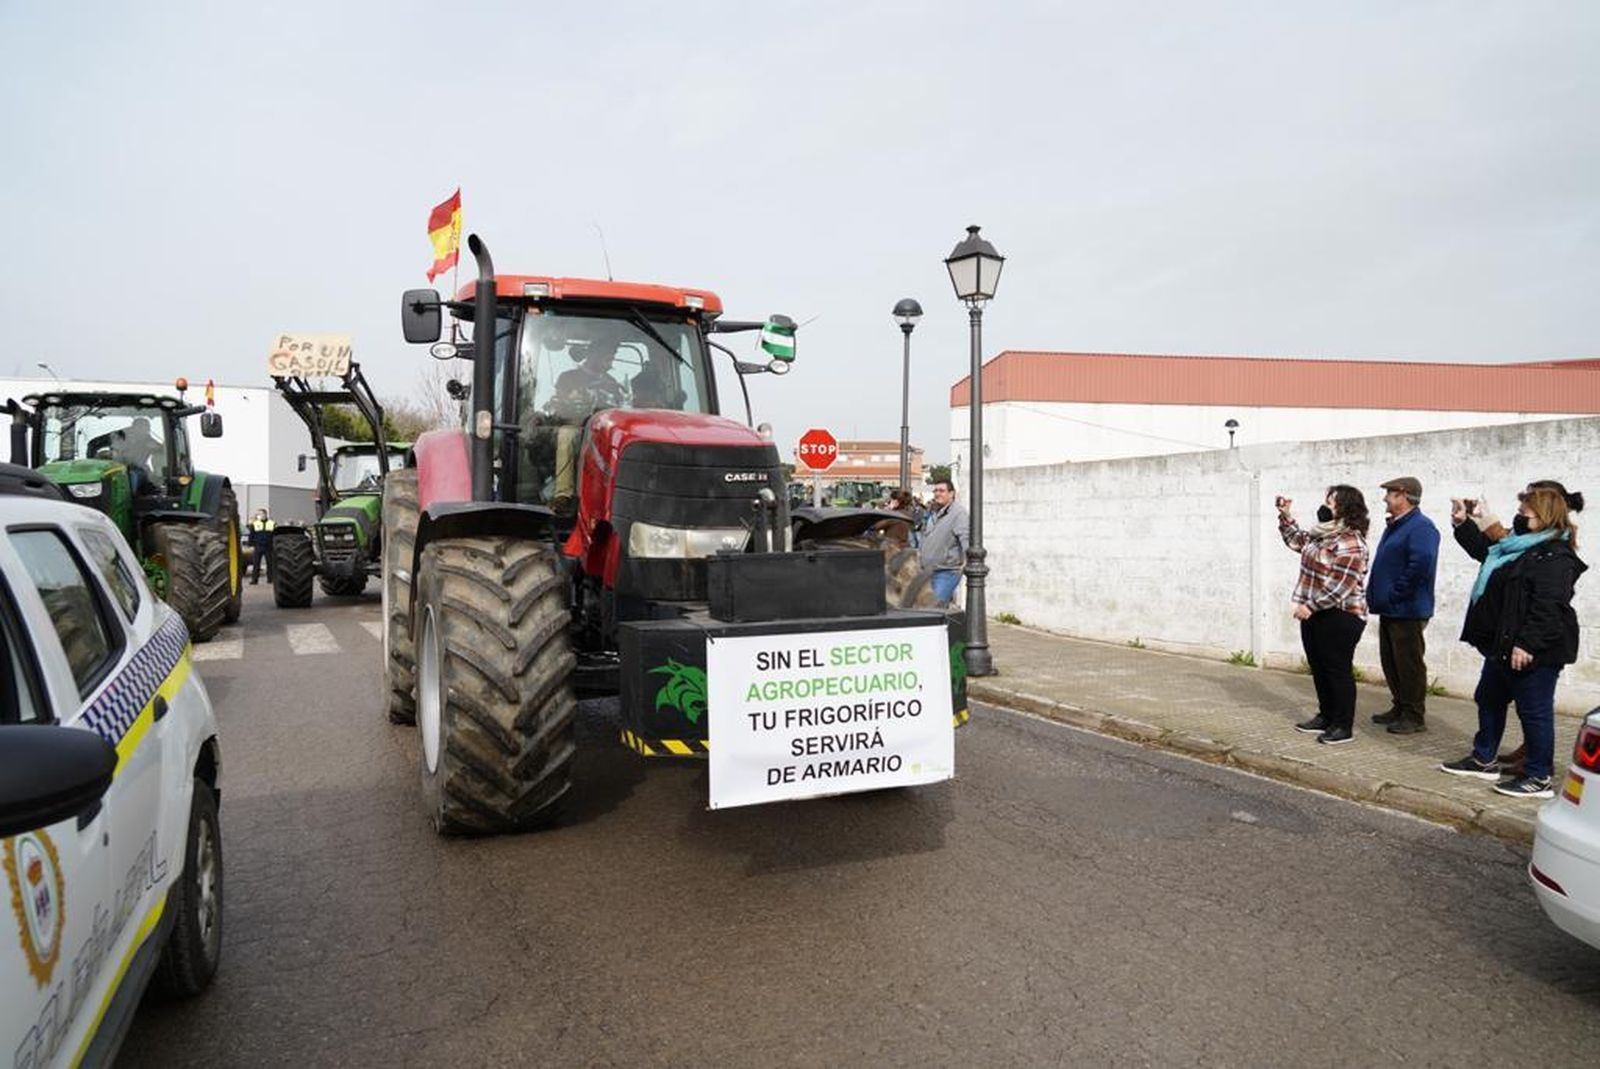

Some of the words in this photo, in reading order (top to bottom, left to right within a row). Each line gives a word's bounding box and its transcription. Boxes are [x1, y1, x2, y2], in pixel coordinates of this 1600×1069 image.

[800, 444, 837, 455] STOP
[724, 472, 756, 482] CASE
[756, 650, 791, 671] SIN
[799, 649, 824, 668] EL
[830, 643, 913, 666] SECTOR
[746, 671, 923, 702] AGROPECUARIO,
[748, 711, 777, 731] TU
[785, 699, 922, 728] FRIGORÍFICO
[791, 727, 885, 757] SERVIRÁ
[767, 766, 796, 785] DE
[802, 754, 902, 781] ARMARIO
